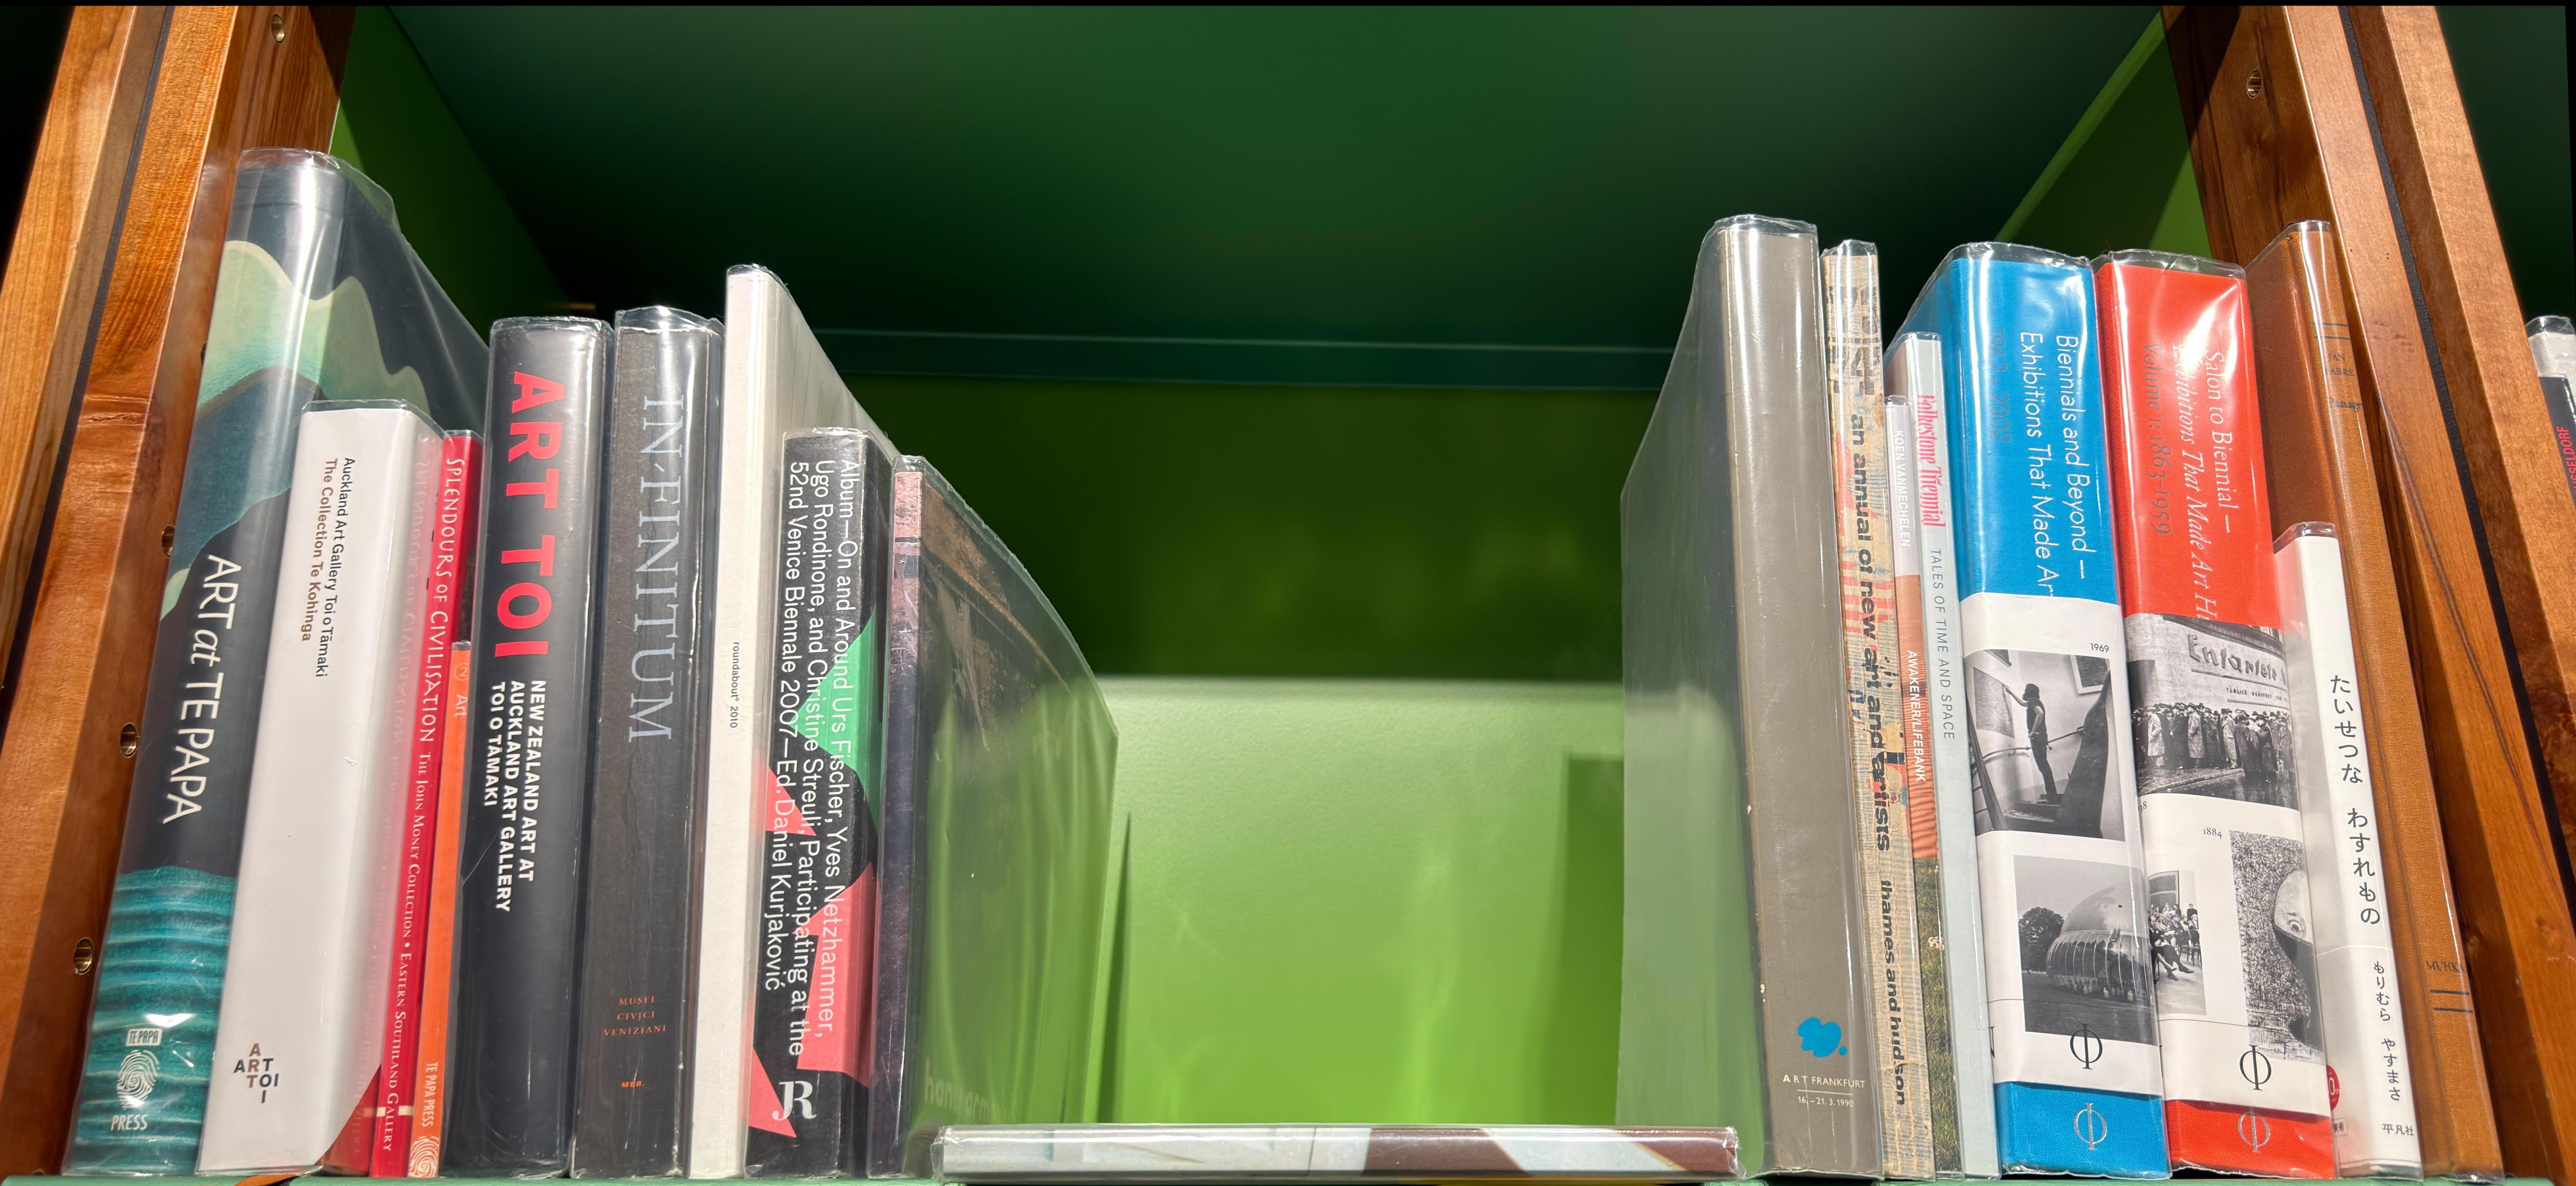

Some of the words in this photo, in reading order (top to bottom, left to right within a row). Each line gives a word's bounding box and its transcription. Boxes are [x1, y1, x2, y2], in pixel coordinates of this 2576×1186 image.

[2057, 335, 2085, 422] Biennials
[2143, 343, 2162, 411] Volume
[2205, 351, 2225, 401] Salon
[2328, 353, 2346, 361] JAN
[2020, 332, 2047, 438] Exhibitions
[1851, 414, 1864, 445] an
[1916, 395, 1938, 464] Folkestone
[1988, 391, 2012, 443] 2002
[2211, 407, 2223, 424] to
[506, 371, 565, 509] ART
[1894, 430, 1904, 460] KOEN
[2063, 427, 2088, 466] and
[323, 458, 337, 482] The
[340, 457, 355, 516] Auckland
[789, 462, 809, 509] 52nd
[810, 460, 835, 497] Ugo
[2029, 445, 2051, 489] That
[2183, 453, 2203, 497] That
[2213, 432, 2239, 516] Biennial
[436, 458, 465, 578] SPLENDOURS
[1854, 453, 1873, 540] annual
[1896, 463, 1910, 547] VANMECHELEN
[1920, 466, 1946, 527] Triennial
[2063, 474, 2096, 553] Beyond
[312, 487, 334, 558] Collection
[336, 520, 348, 541] Art
[2032, 496, 2060, 559] Made
[2186, 497, 2211, 550] Made
[311, 562, 323, 577] Te
[325, 544, 344, 591] Gallery
[786, 515, 808, 580] Venice
[807, 504, 834, 612] Rondinone,
[1857, 549, 1875, 574] of
[1930, 549, 1943, 589] TALES
[198, 554, 241, 629] ART
[434, 584, 448, 603] OF
[836, 576, 856, 610] and
[2037, 565, 2060, 597] Ar
[2191, 552, 2215, 590] Art
[301, 581, 321, 641] Kohinga
[325, 595, 338, 614] Toi
[494, 535, 555, 658] TOI
[1860, 580, 1876, 640] new
[1934, 596, 1945, 613] OF
[191, 629, 221, 667] at
[782, 586, 805, 673] Biennale
[809, 618, 828, 652] and
[1936, 621, 1948, 652] TIME
[2090, 643, 2109, 652] 1969
[420, 611, 449, 742] CIVILISATION
[833, 618, 855, 689] Around
[1864, 648, 1881, 689] art
[1939, 659, 1950, 688] AND
[181, 673, 223, 720] TE
[455, 694, 468, 717] Art
[490, 682, 505, 712] TOI
[529, 680, 546, 721] NEW
[730, 706, 738, 728] 2010
[804, 659, 828, 751] Christine
[832, 697, 852, 733] Urs
[1907, 650, 1926, 782] AWAKENER/LIFEBANK
[1942, 694, 1954, 739] SPACE
[489, 717, 503, 730] O
[504, 680, 525, 779] AUCKLAND
[1867, 695, 1886, 749] and
[163, 728, 215, 824] PAPA
[484, 736, 502, 806] TĀMAKI
[522, 726, 543, 811] ZEALAND
[824, 741, 851, 823] Fischer,
[502, 785, 518, 821] ART
[797, 759, 824, 834] Streuli,
[1871, 756, 1890, 851] artists
[2330, 675, 2363, 783] たいせつな
[2347, 807, 2380, 925] わすれもの
[520, 817, 537, 853] ART
[772, 799, 795, 867] Daniel
[825, 826, 848, 878] Yves
[2203, 827, 2222, 839] 1884
[495, 826, 515, 912] GALLERY
[519, 859, 533, 881] AT
[763, 875, 791, 991] Kurjaković
[788, 840, 820, 983] Participating
[1881, 879, 1894, 964] thames
[815, 885, 846, 1037] Netzhammer,
[619, 996, 655, 1006] MUSEI
[791, 990, 810, 1012] at
[1886, 968, 1901, 1011] and
[129, 1031, 137, 1042] TE
[138, 1030, 159, 1042] PAPA
[604, 1024, 667, 1036] VENIZIANI
[617, 1011, 655, 1021] CIVICI
[789, 1020, 810, 1056] the
[2374, 961, 2390, 1022] もりむら
[2382, 1038, 2400, 1101] やすまさ
[426, 1062, 438, 1073] TE
[1783, 1075, 1807, 1083] ART
[1812, 1076, 1865, 1088] FRANKFURT
[1890, 1017, 1905, 1105] hudson
[425, 1074, 437, 1099] PAPA
[110, 1114, 148, 1131] PRESS
[421, 1100, 436, 1127] PRESS
[2383, 1123, 2414, 1136] 平凡社
